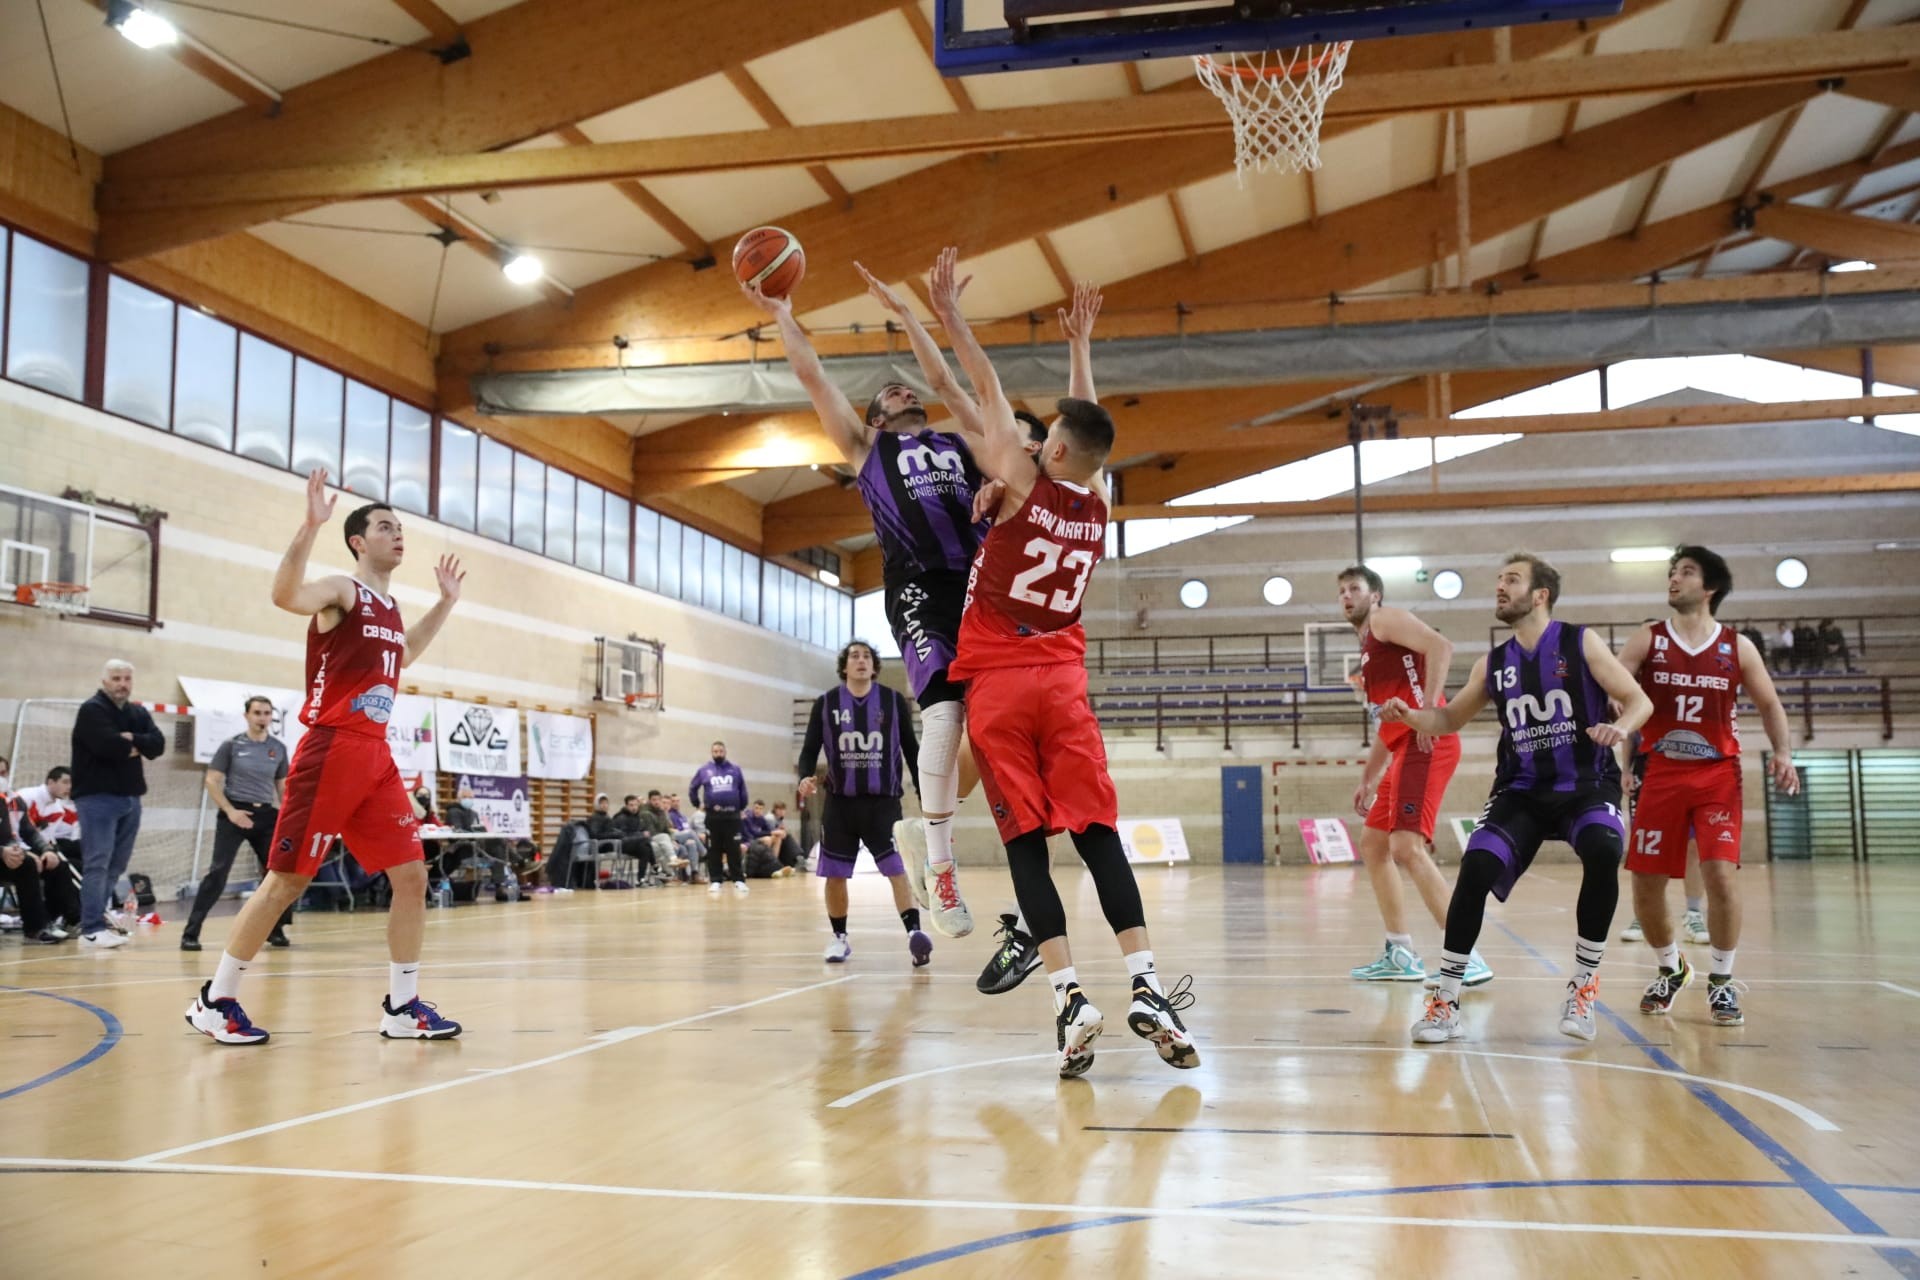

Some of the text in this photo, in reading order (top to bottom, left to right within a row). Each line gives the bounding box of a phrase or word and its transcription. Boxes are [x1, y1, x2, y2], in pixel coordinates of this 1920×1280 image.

[1028, 504, 1102, 542] SAN MARTÍN
[1008, 536, 1094, 614] 23
[363, 624, 379, 638] CB
[903, 607, 932, 662] LANA
[382, 649, 397, 679] 11
[1402, 654, 1415, 669] CB
[1493, 665, 1518, 692] 13
[1653, 671, 1729, 691] CB SOLARES
[832, 709, 851, 726] 14
[1675, 694, 1704, 723] 12
[840, 752, 883, 761] MONDRAGON
[310, 831, 334, 859] 11
[1635, 828, 1663, 855] 12
